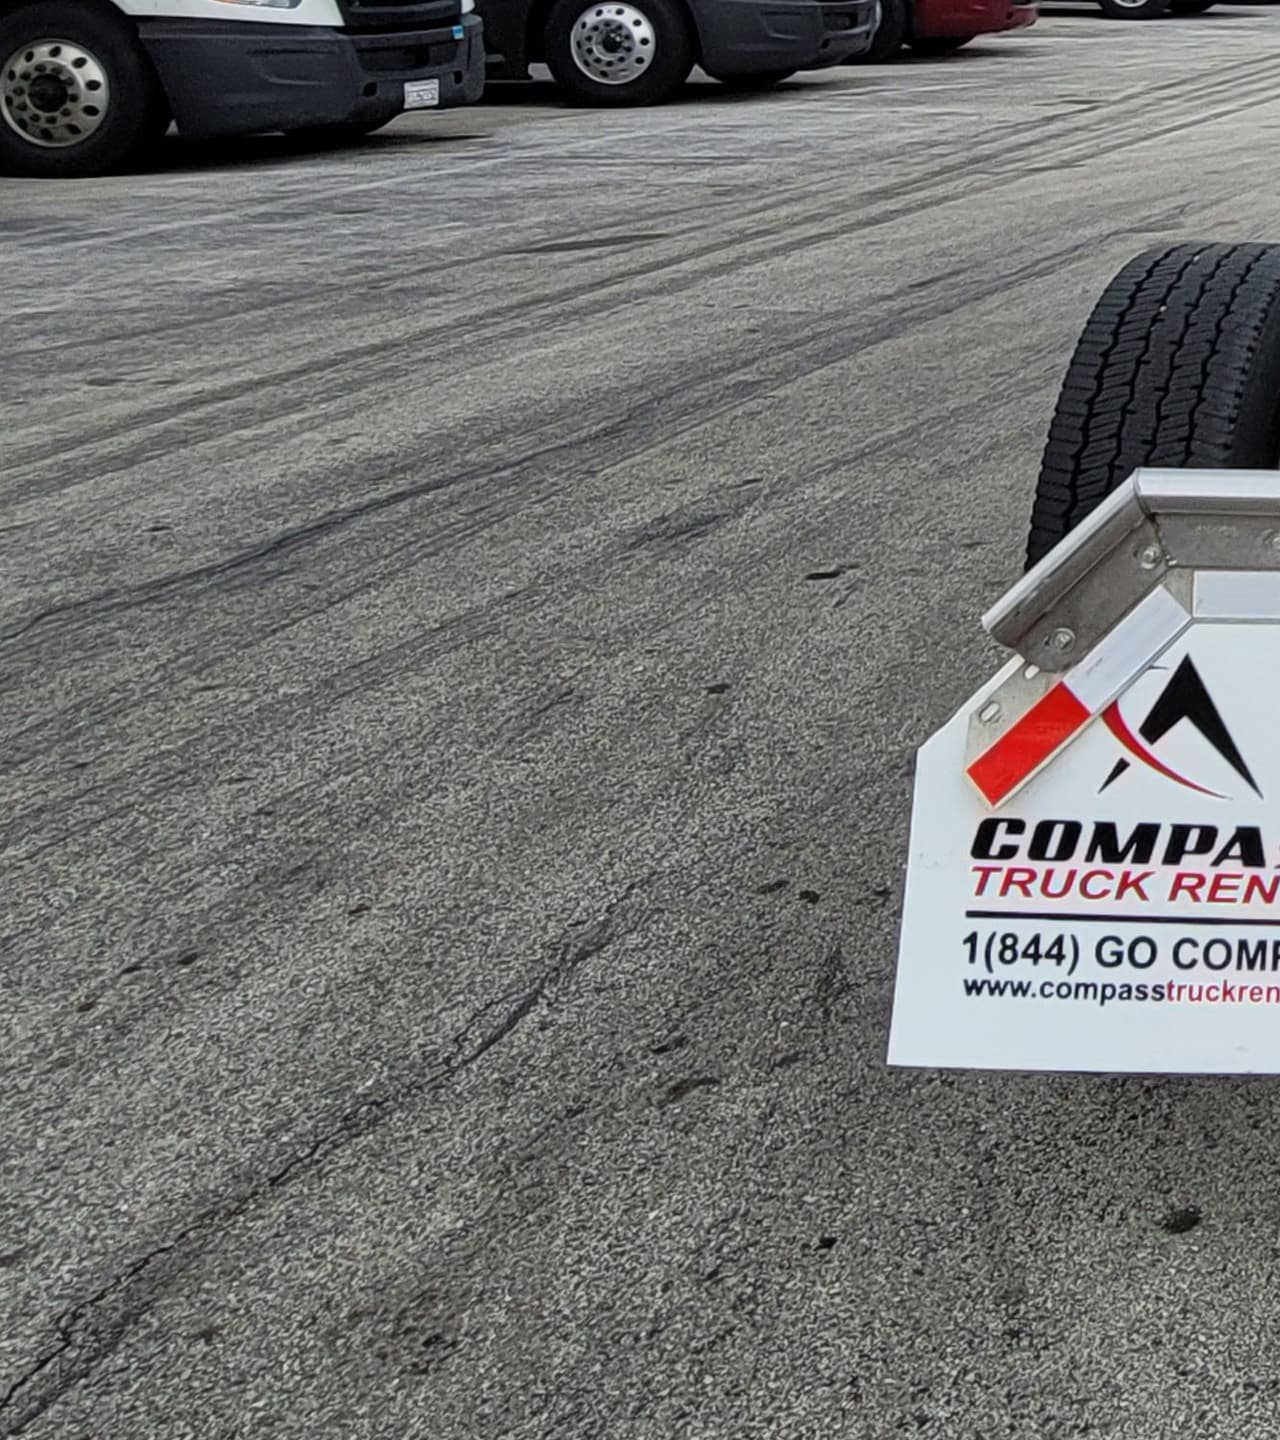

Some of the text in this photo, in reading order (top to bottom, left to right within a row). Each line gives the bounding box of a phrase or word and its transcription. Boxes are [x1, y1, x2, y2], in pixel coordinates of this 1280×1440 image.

[971, 866, 1155, 901] TRUCK
[962, 931, 1080, 977] 1(844)
[1094, 935, 1158, 970] GO
